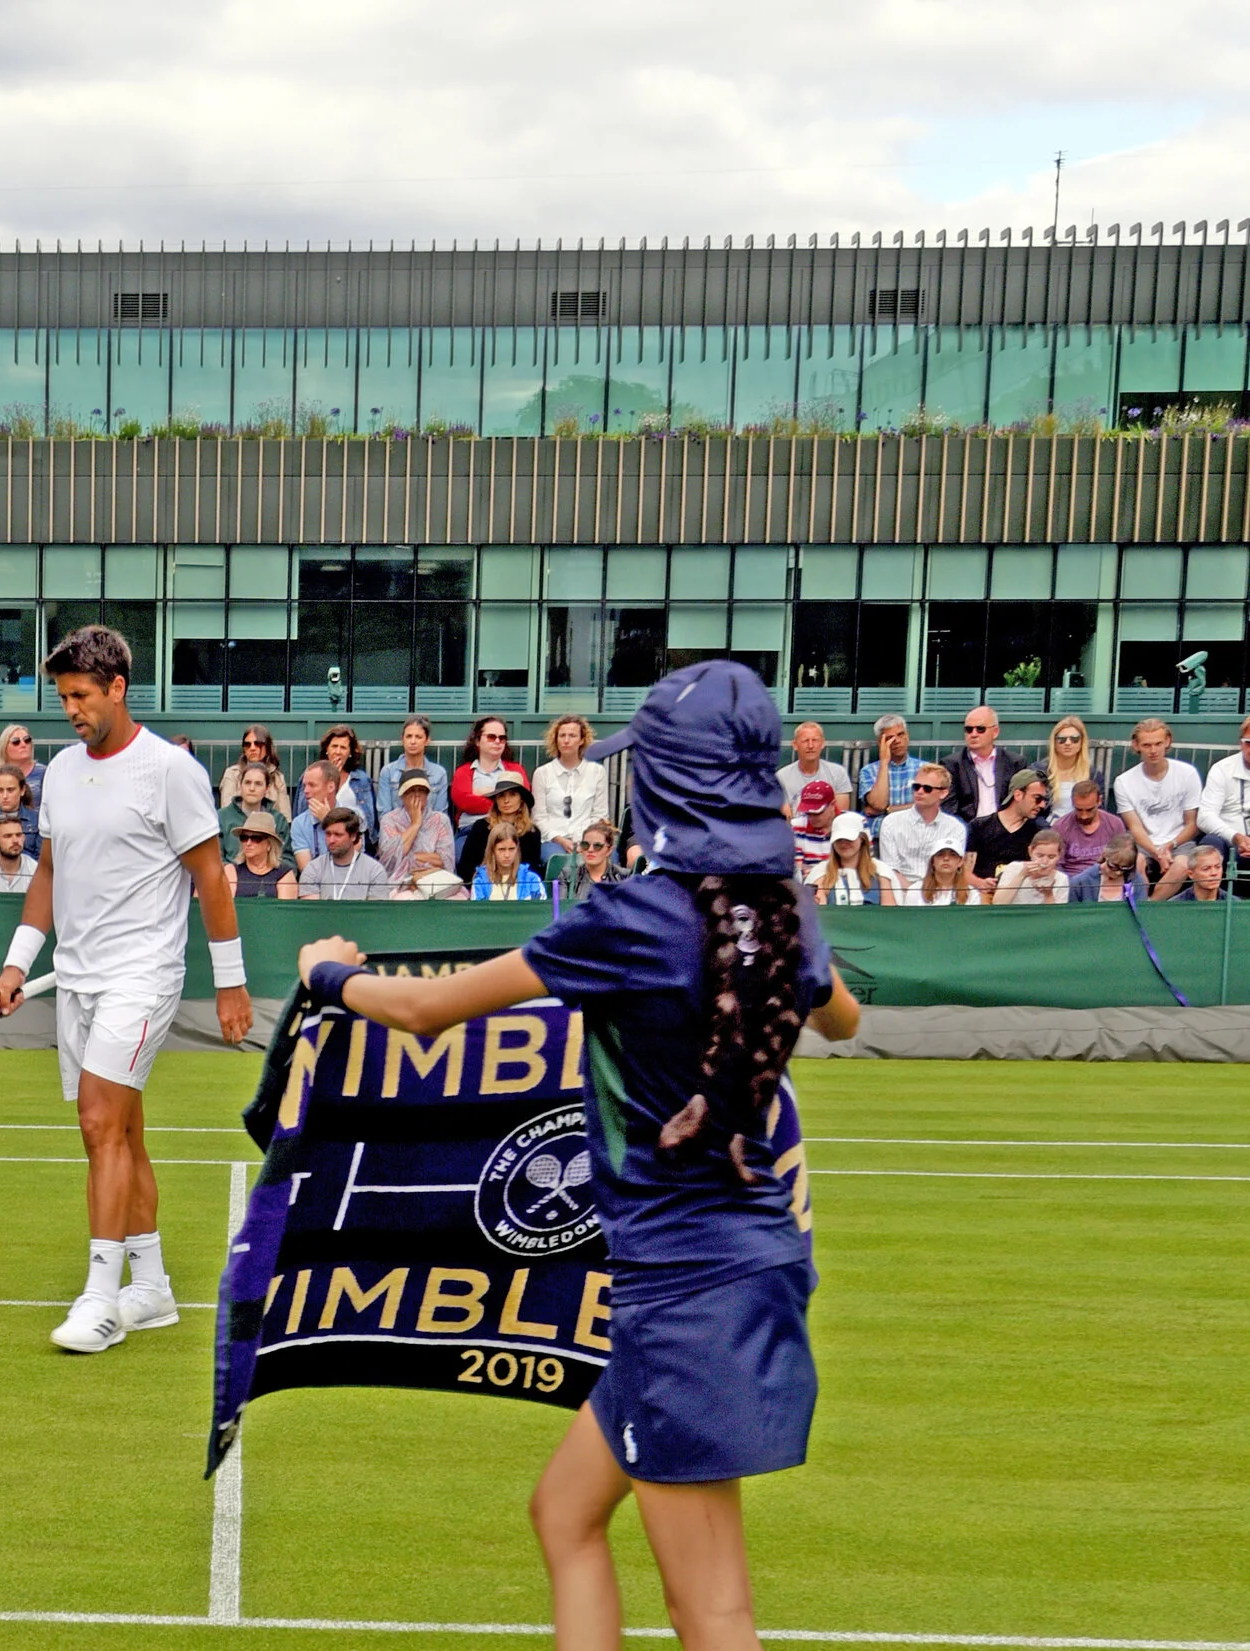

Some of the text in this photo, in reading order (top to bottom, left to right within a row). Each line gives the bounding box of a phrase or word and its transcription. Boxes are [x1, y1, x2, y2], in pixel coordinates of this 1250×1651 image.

[488, 1148, 517, 1182] THE
[494, 1213, 600, 1250] WIMBLEDON
[262, 1267, 614, 1352] IMBLE
[457, 1349, 565, 1393] 2019
